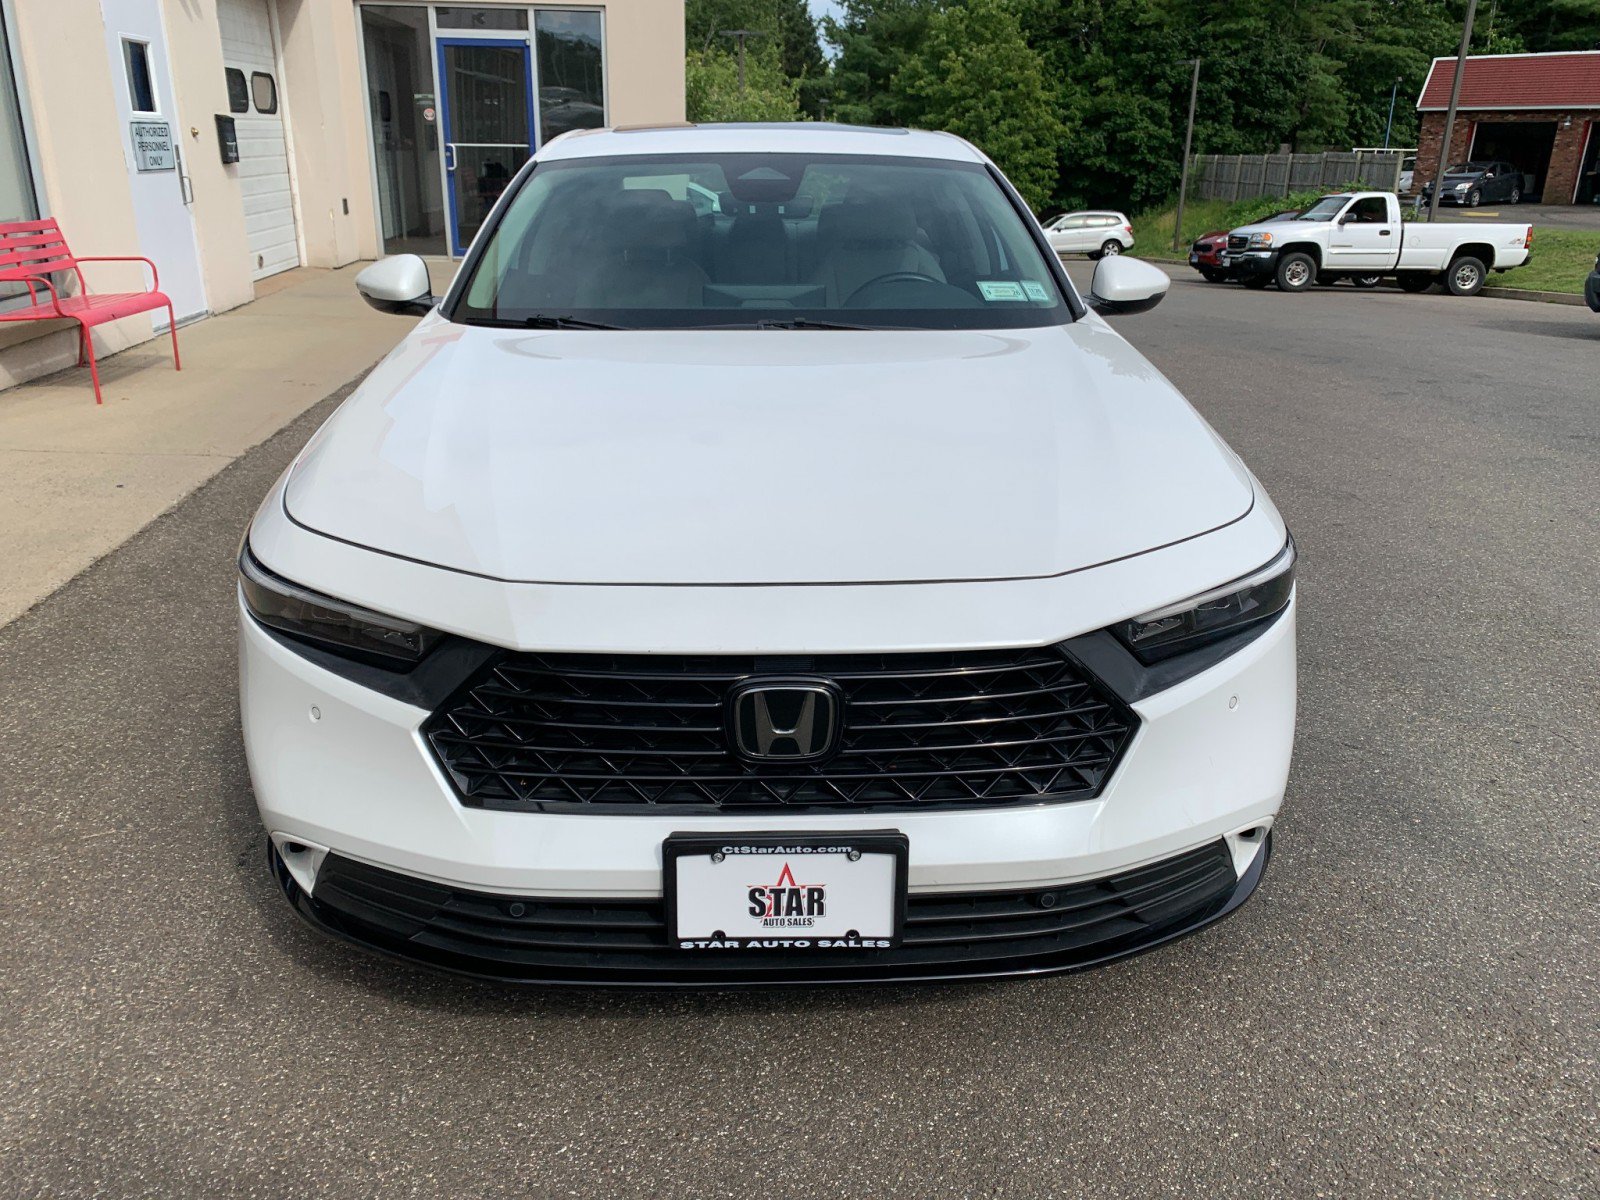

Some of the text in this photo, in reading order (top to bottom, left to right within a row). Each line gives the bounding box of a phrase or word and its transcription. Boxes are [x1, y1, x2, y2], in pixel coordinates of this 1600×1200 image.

[135, 127, 168, 137] AUTHORIZED
[138, 141, 170, 152] PERSONNEL
[149, 156, 163, 166] ONLY
[721, 845, 852, 854] CtStarAuto.com
[748, 887, 825, 917] STAR
[763, 917, 813, 926] AUTO SALES
[680, 939, 891, 949] STAR AUTO SALES
